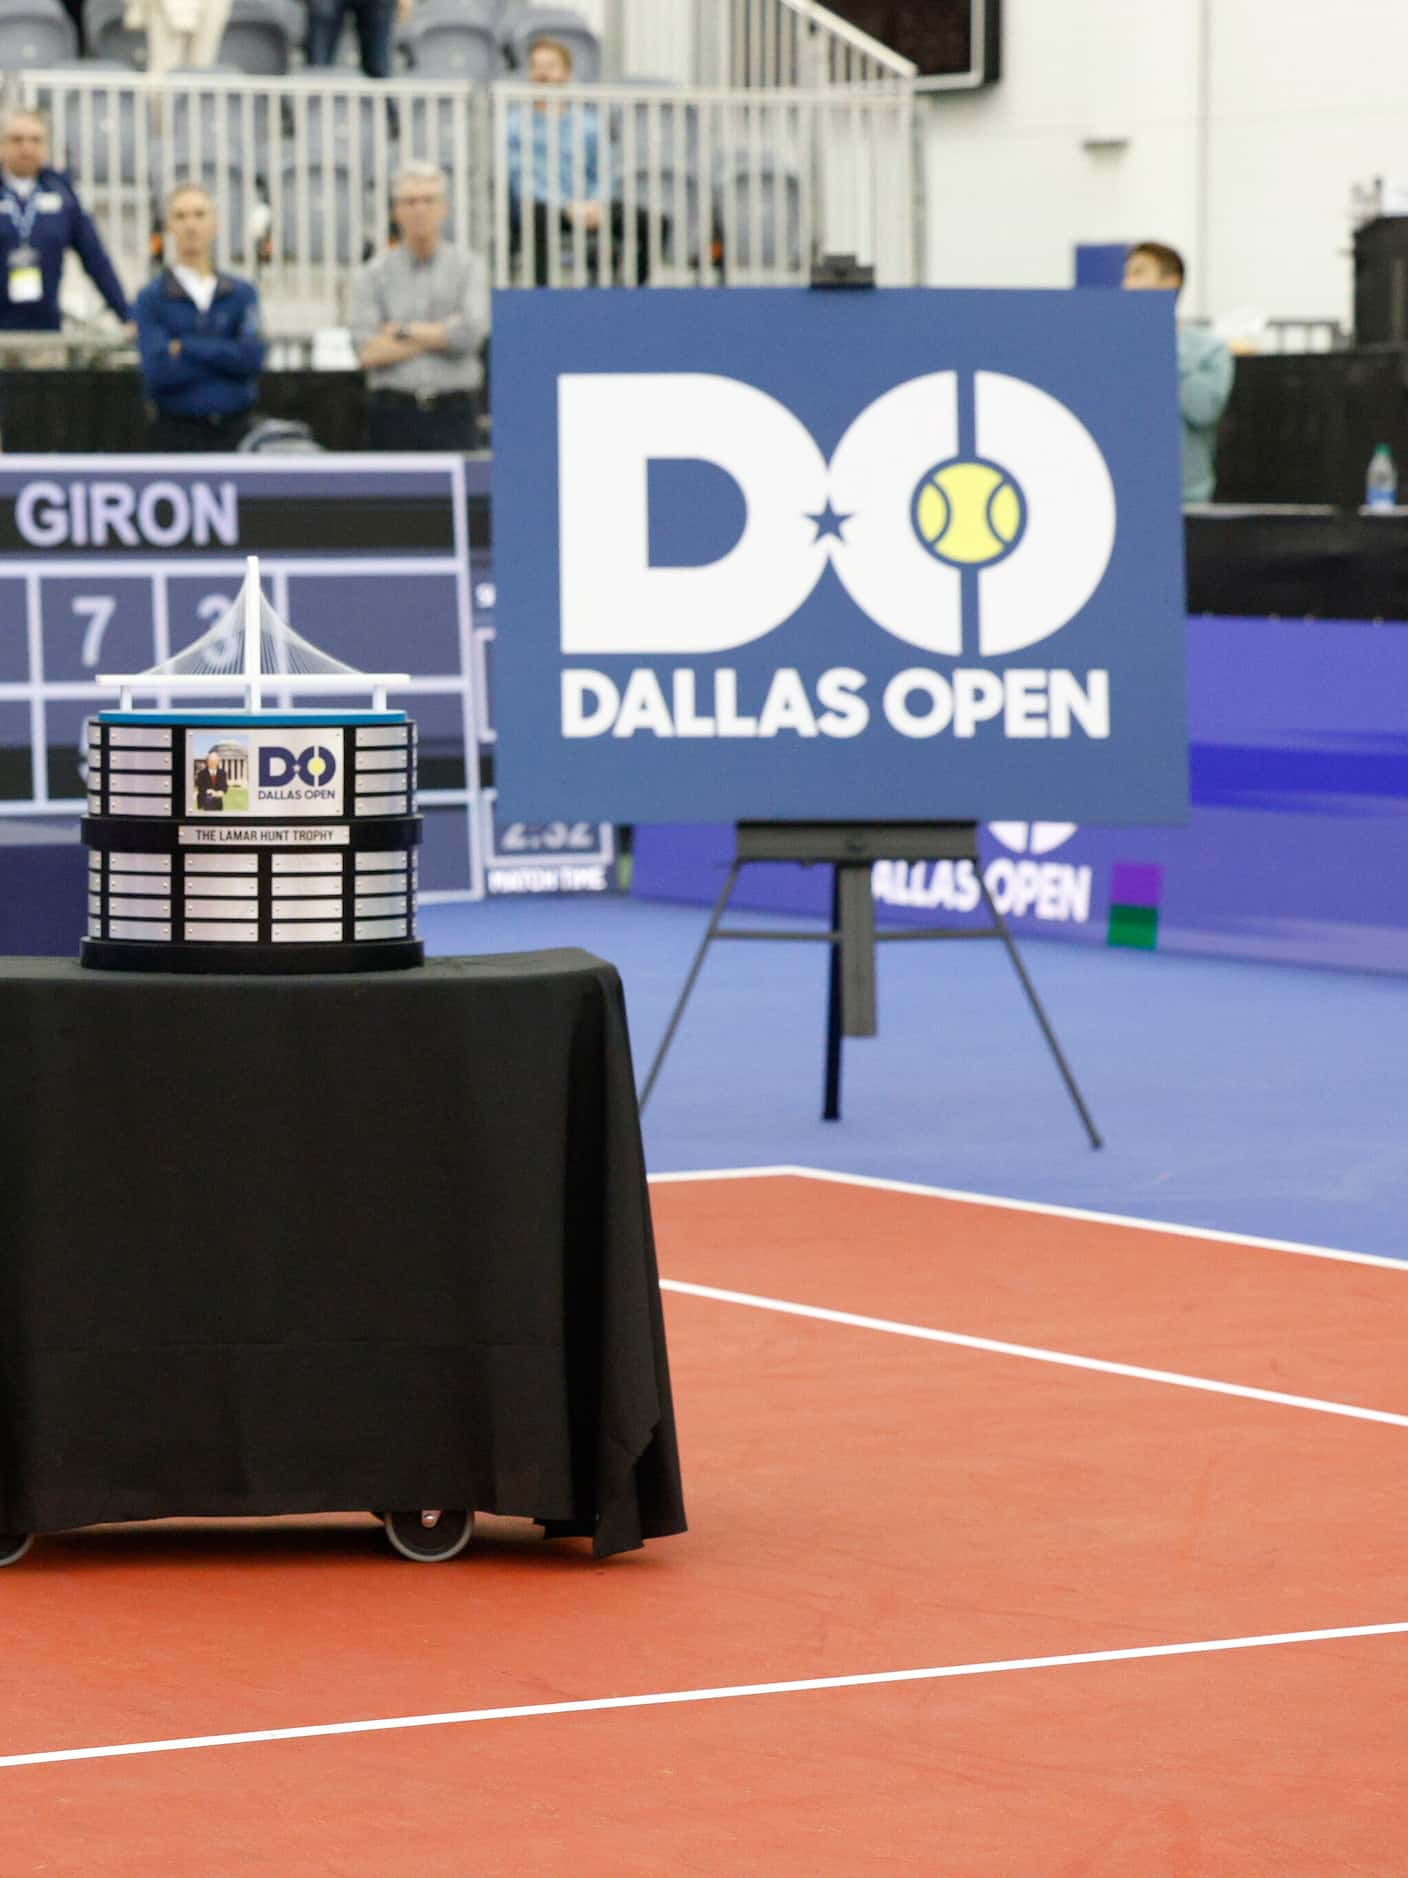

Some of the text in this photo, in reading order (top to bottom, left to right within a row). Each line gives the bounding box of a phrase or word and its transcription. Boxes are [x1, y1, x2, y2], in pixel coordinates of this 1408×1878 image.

[15, 480, 240, 548] GIRON
[71, 596, 117, 667] 7
[560, 667, 1110, 739] DALLAS OPEN
[258, 788, 336, 800] DALLAS OPEN
[195, 829, 334, 841] THE LAMAR HUNT TROPHY
[983, 857, 1093, 923] OPEN
